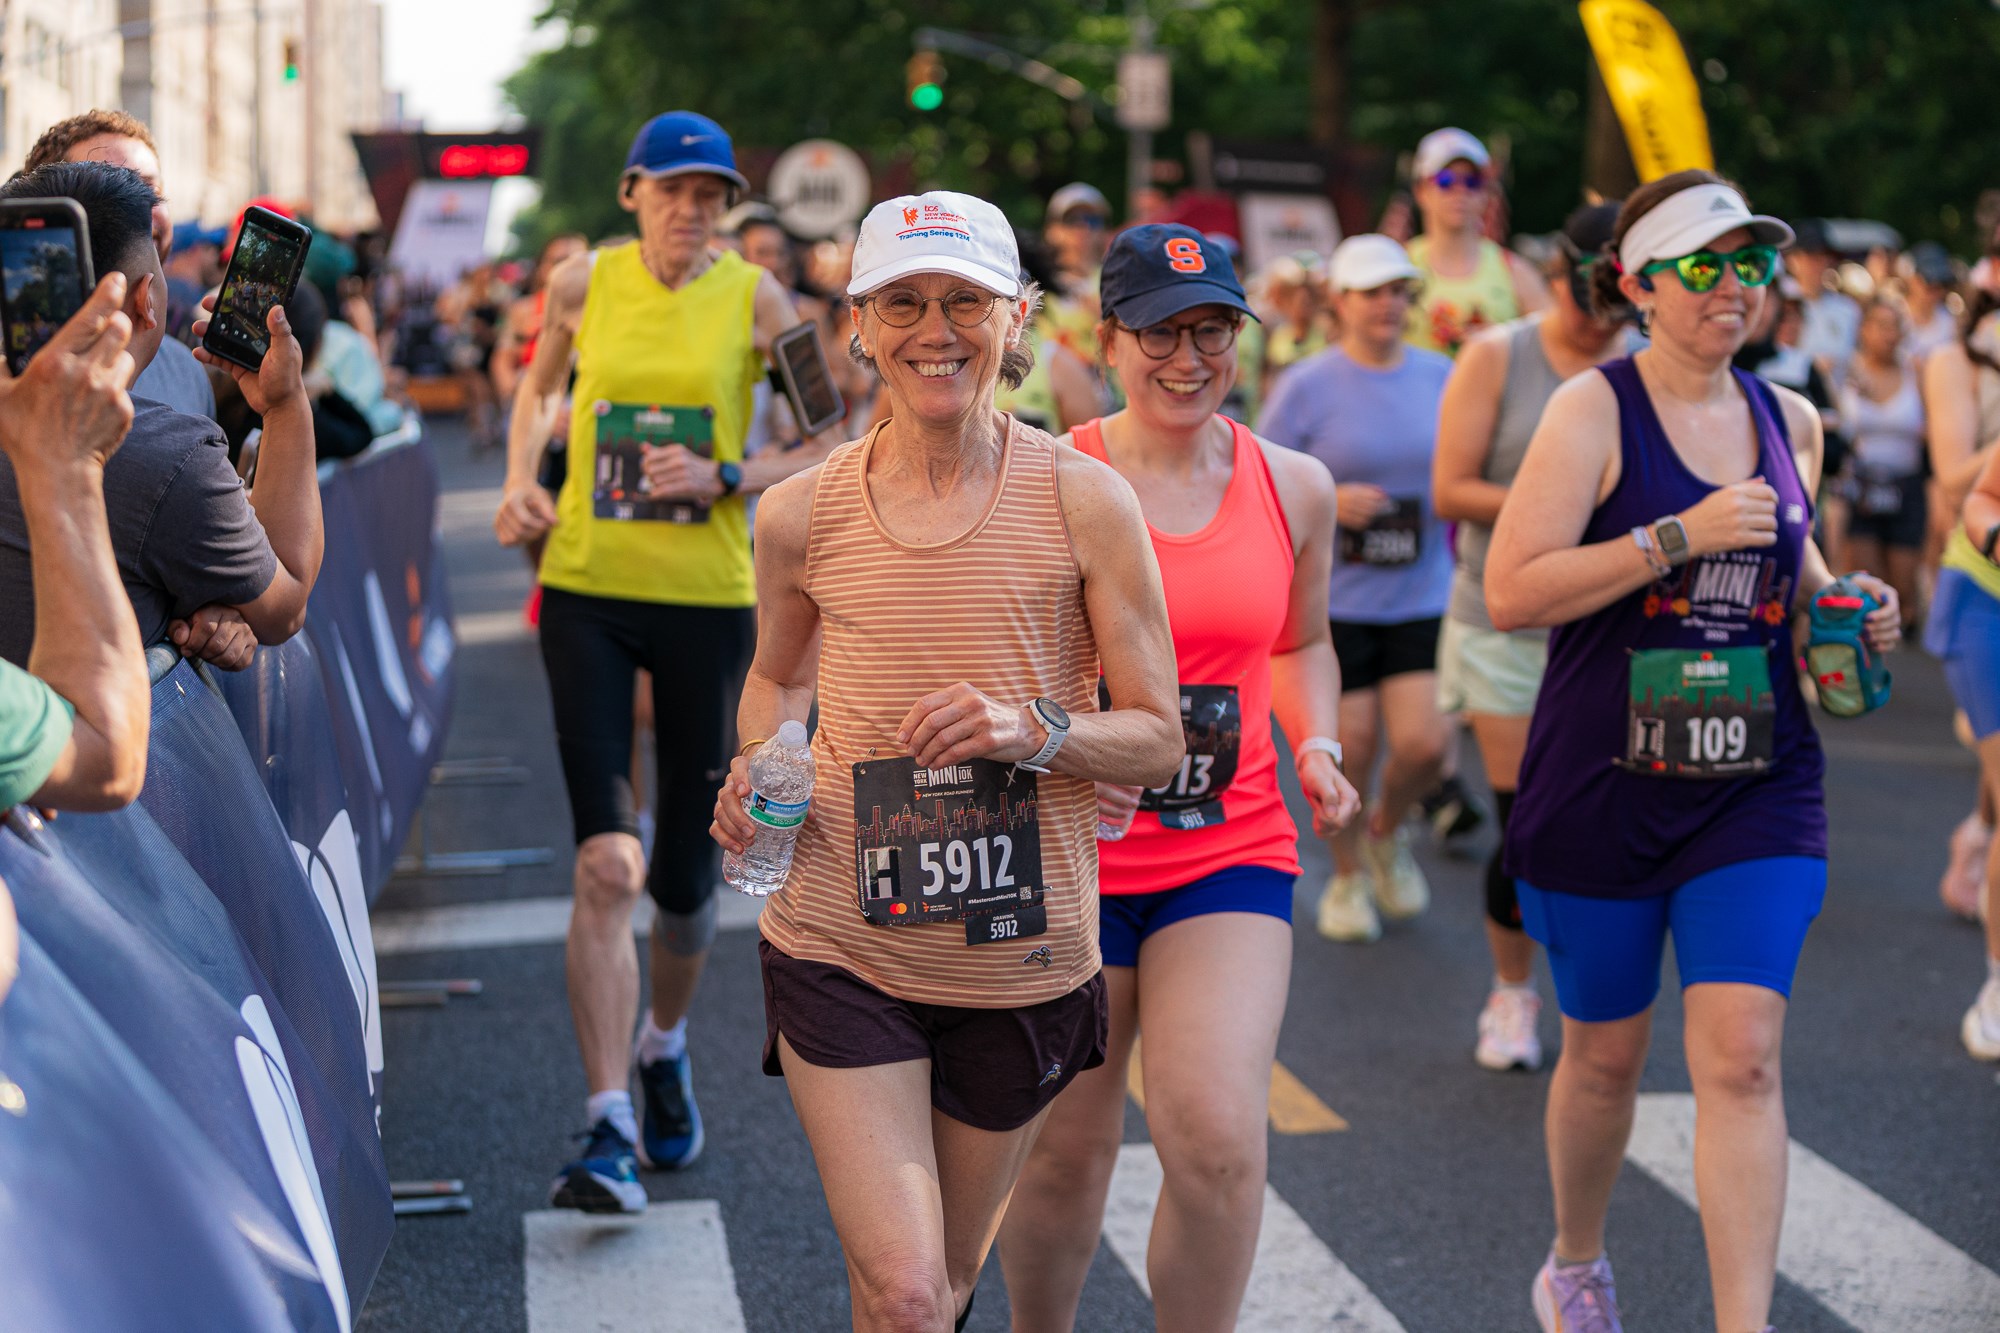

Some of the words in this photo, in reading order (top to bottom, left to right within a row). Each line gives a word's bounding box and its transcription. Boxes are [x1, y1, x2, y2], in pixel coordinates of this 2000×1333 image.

[899, 231, 929, 241] Training
[930, 229, 954, 238] Series
[1164, 238, 1207, 274] S
[1693, 562, 1759, 607] MINI
[1686, 715, 1747, 762] 109
[913, 772, 927, 780] NEW
[928, 765, 958, 787] MINI
[958, 768, 973, 781] 10K
[920, 834, 1015, 896] 5912
[990, 920, 1018, 939] 5912
